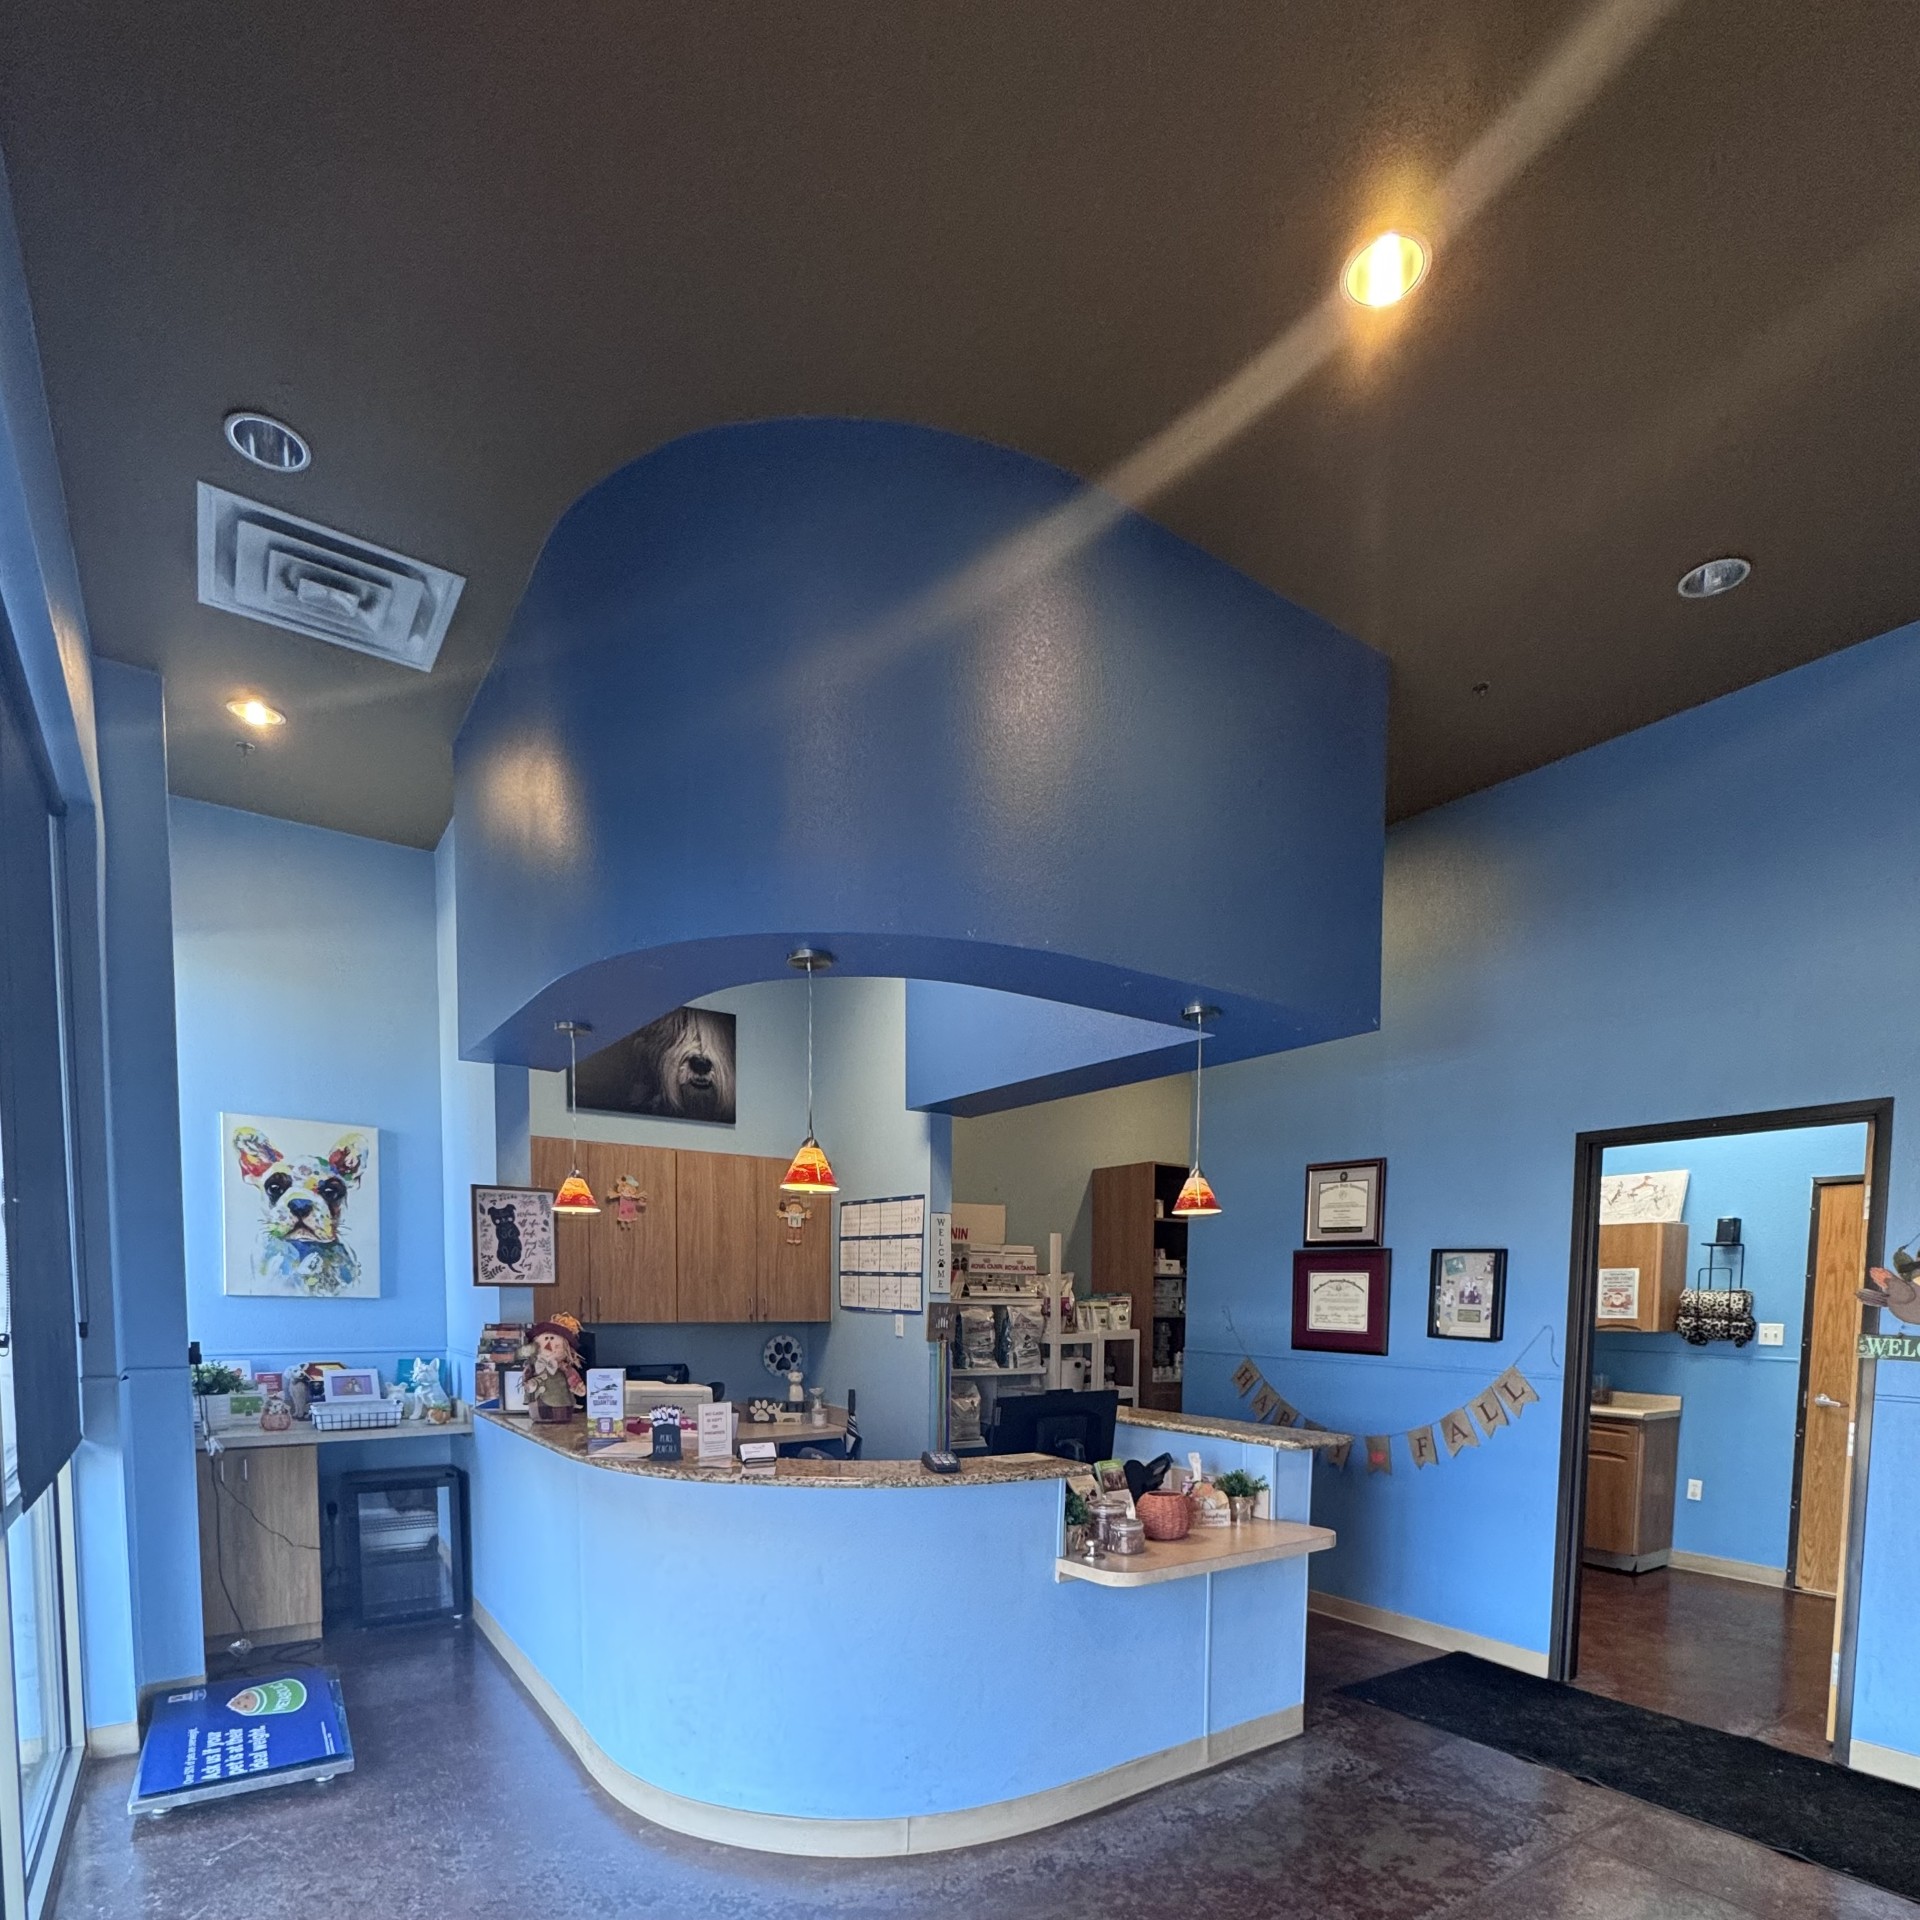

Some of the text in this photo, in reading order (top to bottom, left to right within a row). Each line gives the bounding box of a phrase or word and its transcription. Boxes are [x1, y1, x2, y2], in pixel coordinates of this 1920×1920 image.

[1415, 1380, 1526, 1458] FALL
[200, 1731, 225, 1780] Ask us if your
[224, 1728, 248, 1775] pet is at their
[248, 1725, 271, 1772] ideal weight.
